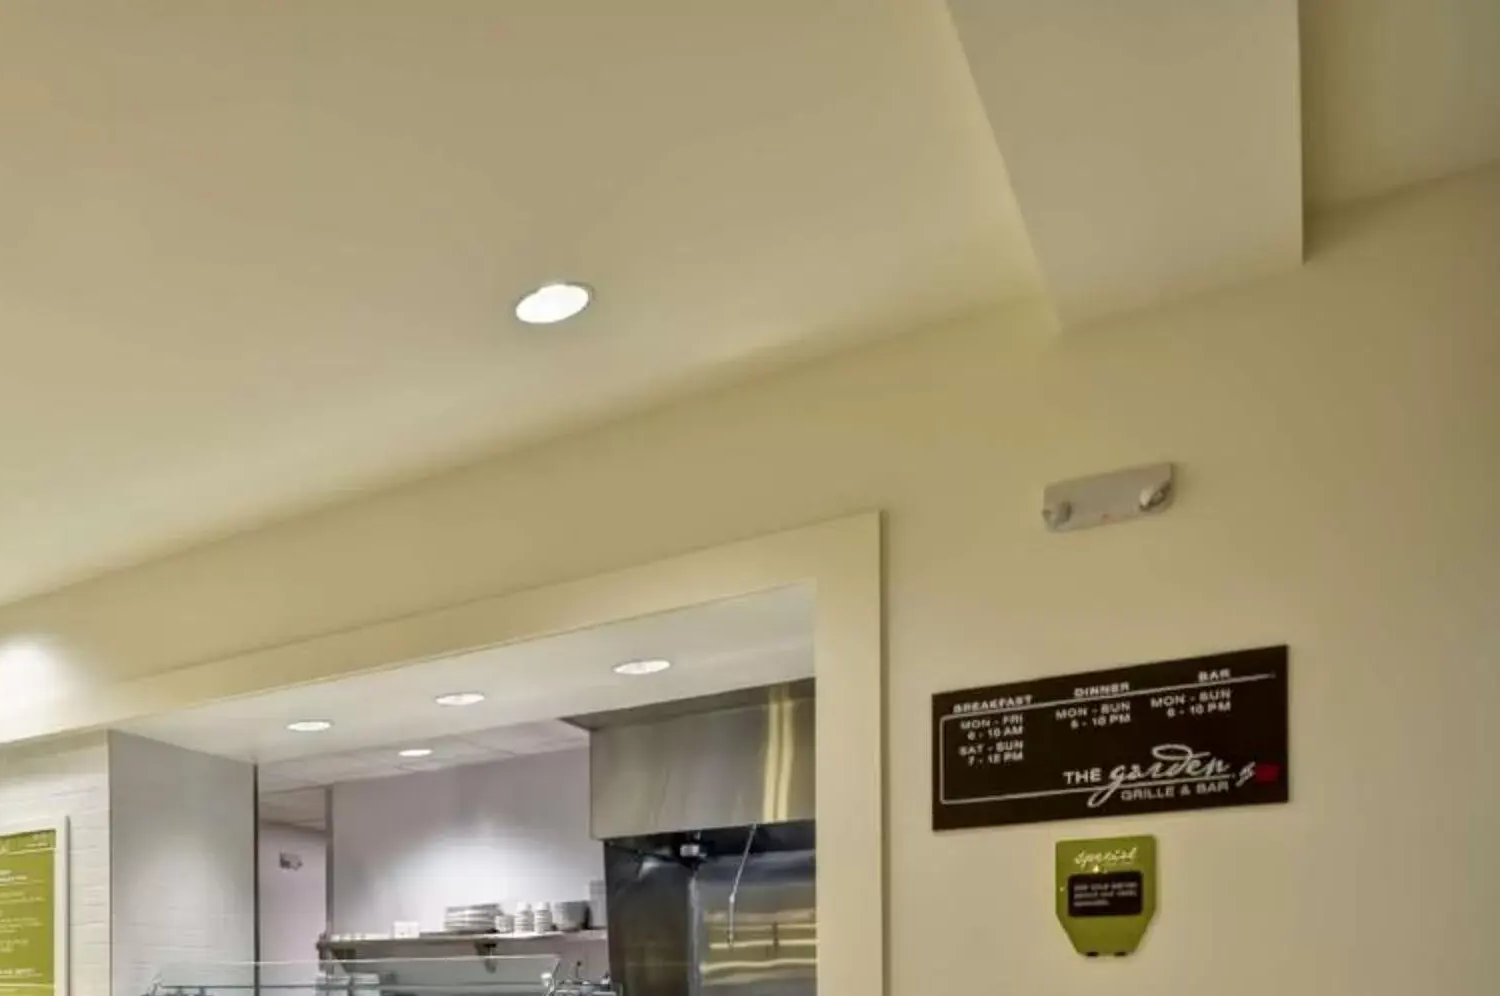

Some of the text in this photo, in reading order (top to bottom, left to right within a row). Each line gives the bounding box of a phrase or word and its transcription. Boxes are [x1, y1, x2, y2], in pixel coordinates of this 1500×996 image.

[1198, 668, 1231, 682] BAR
[1074, 681, 1130, 698] DINNER
[953, 694, 1033, 714] BREAKFAST
[1150, 693, 1186, 709] MON
[1199, 688, 1231, 702] SUN
[1055, 707, 1088, 721] MON
[1101, 702, 1131, 716] SUN
[1190, 703, 1205, 716] 10
[1207, 700, 1231, 713] PM
[960, 719, 991, 730] MON
[1003, 713, 1023, 726] FRI
[1092, 715, 1107, 728] 10
[1109, 713, 1131, 726] PM
[1004, 725, 1023, 737] AM
[959, 743, 985, 757] SAT
[996, 740, 1023, 753] SUN
[1003, 751, 1023, 764] PM
[1063, 744, 1230, 808] THE garden
[1120, 780, 1230, 801] GRILLE & BAR
